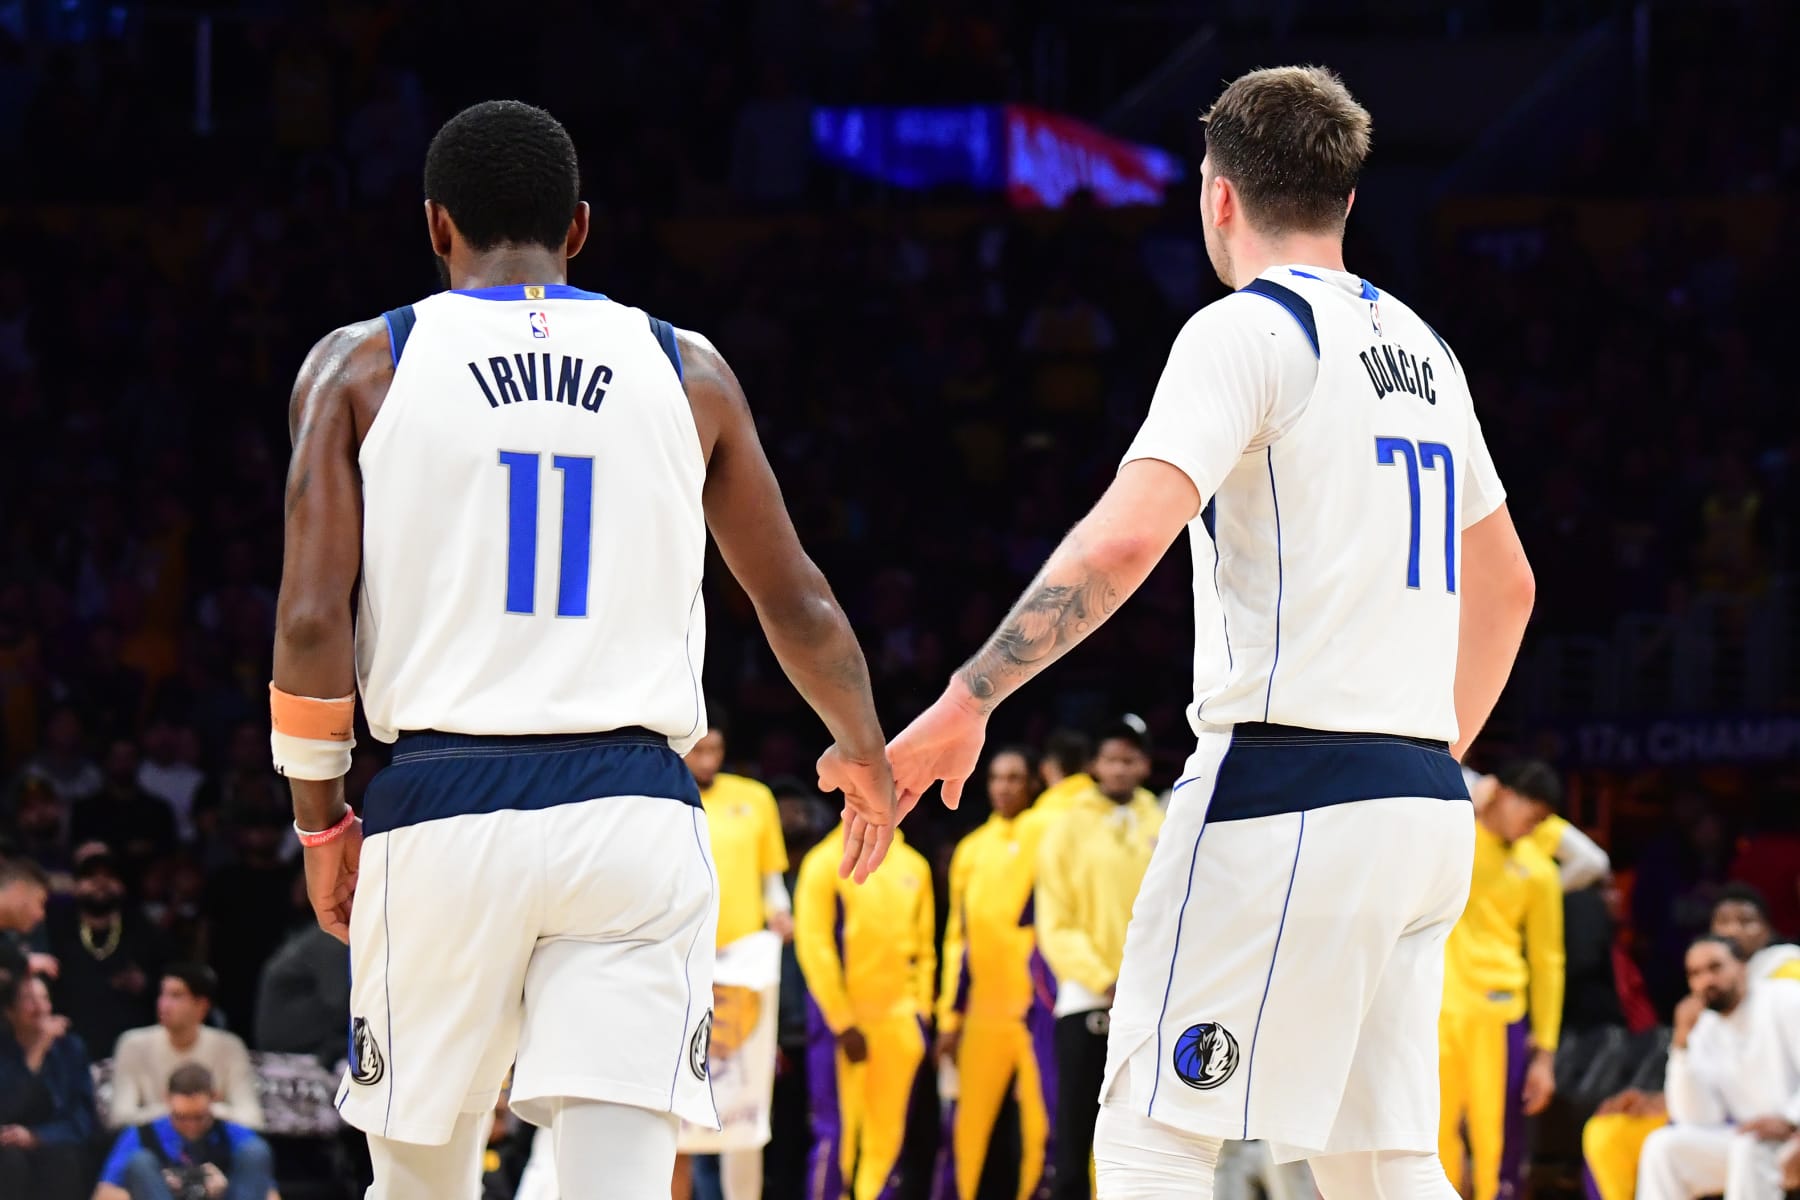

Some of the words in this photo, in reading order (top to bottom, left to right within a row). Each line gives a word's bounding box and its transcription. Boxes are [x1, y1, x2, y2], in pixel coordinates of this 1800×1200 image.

[468, 352, 613, 413] IRVING
[1359, 342, 1436, 405] DONČIĆ
[497, 448, 596, 618] 11
[1374, 434, 1456, 595] 77
